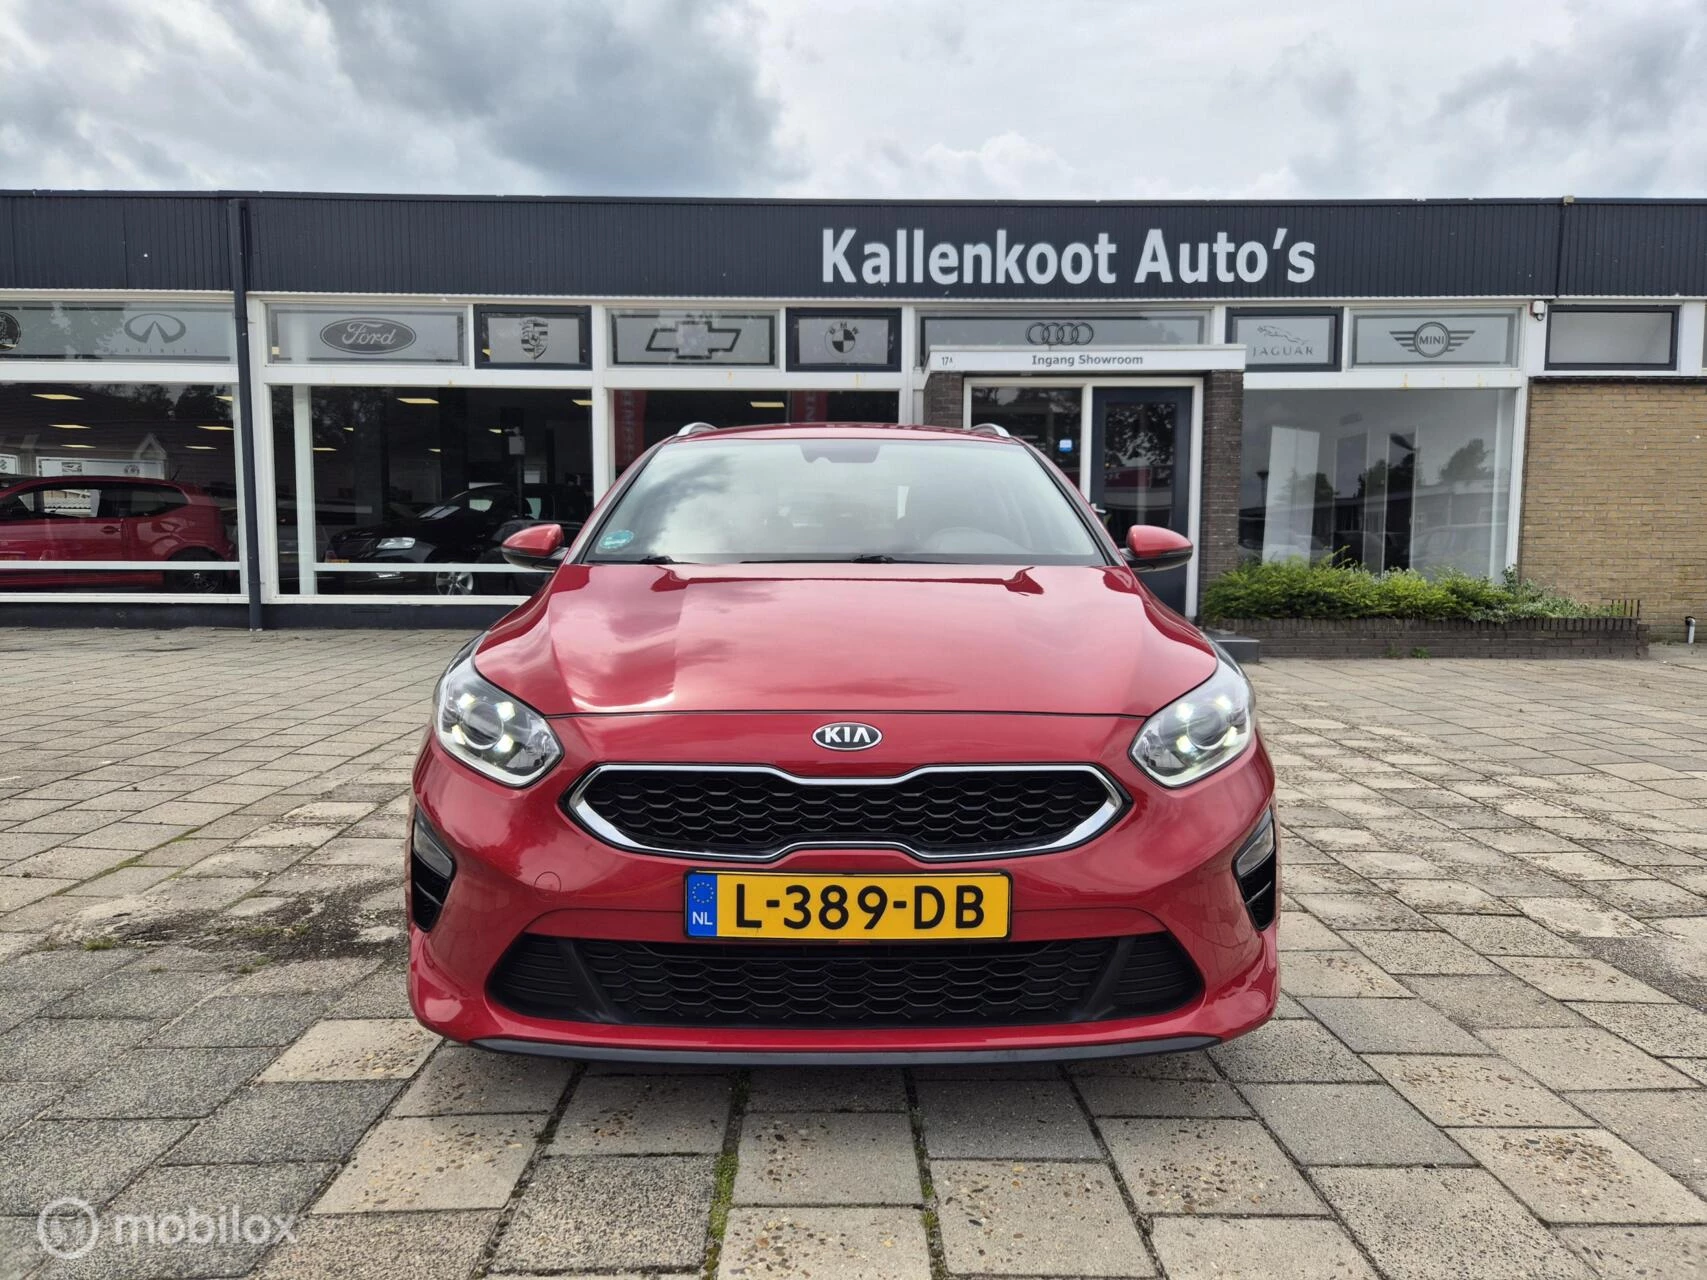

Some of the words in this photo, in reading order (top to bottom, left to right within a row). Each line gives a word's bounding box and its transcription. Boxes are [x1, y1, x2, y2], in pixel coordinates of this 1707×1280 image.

[822, 228, 1117, 284] Kallenkoot
[1134, 227, 1316, 284] Auto's
[342, 322, 396, 345] Ford
[1419, 335, 1445, 345] MINI
[1253, 346, 1313, 356] JAGUAR
[1032, 355, 1075, 367] Ingang
[1078, 354, 1144, 365] Showroom
[824, 726, 871, 743] KIA
[736, 884, 984, 930] L-389-DB
[692, 911, 713, 926] NL
